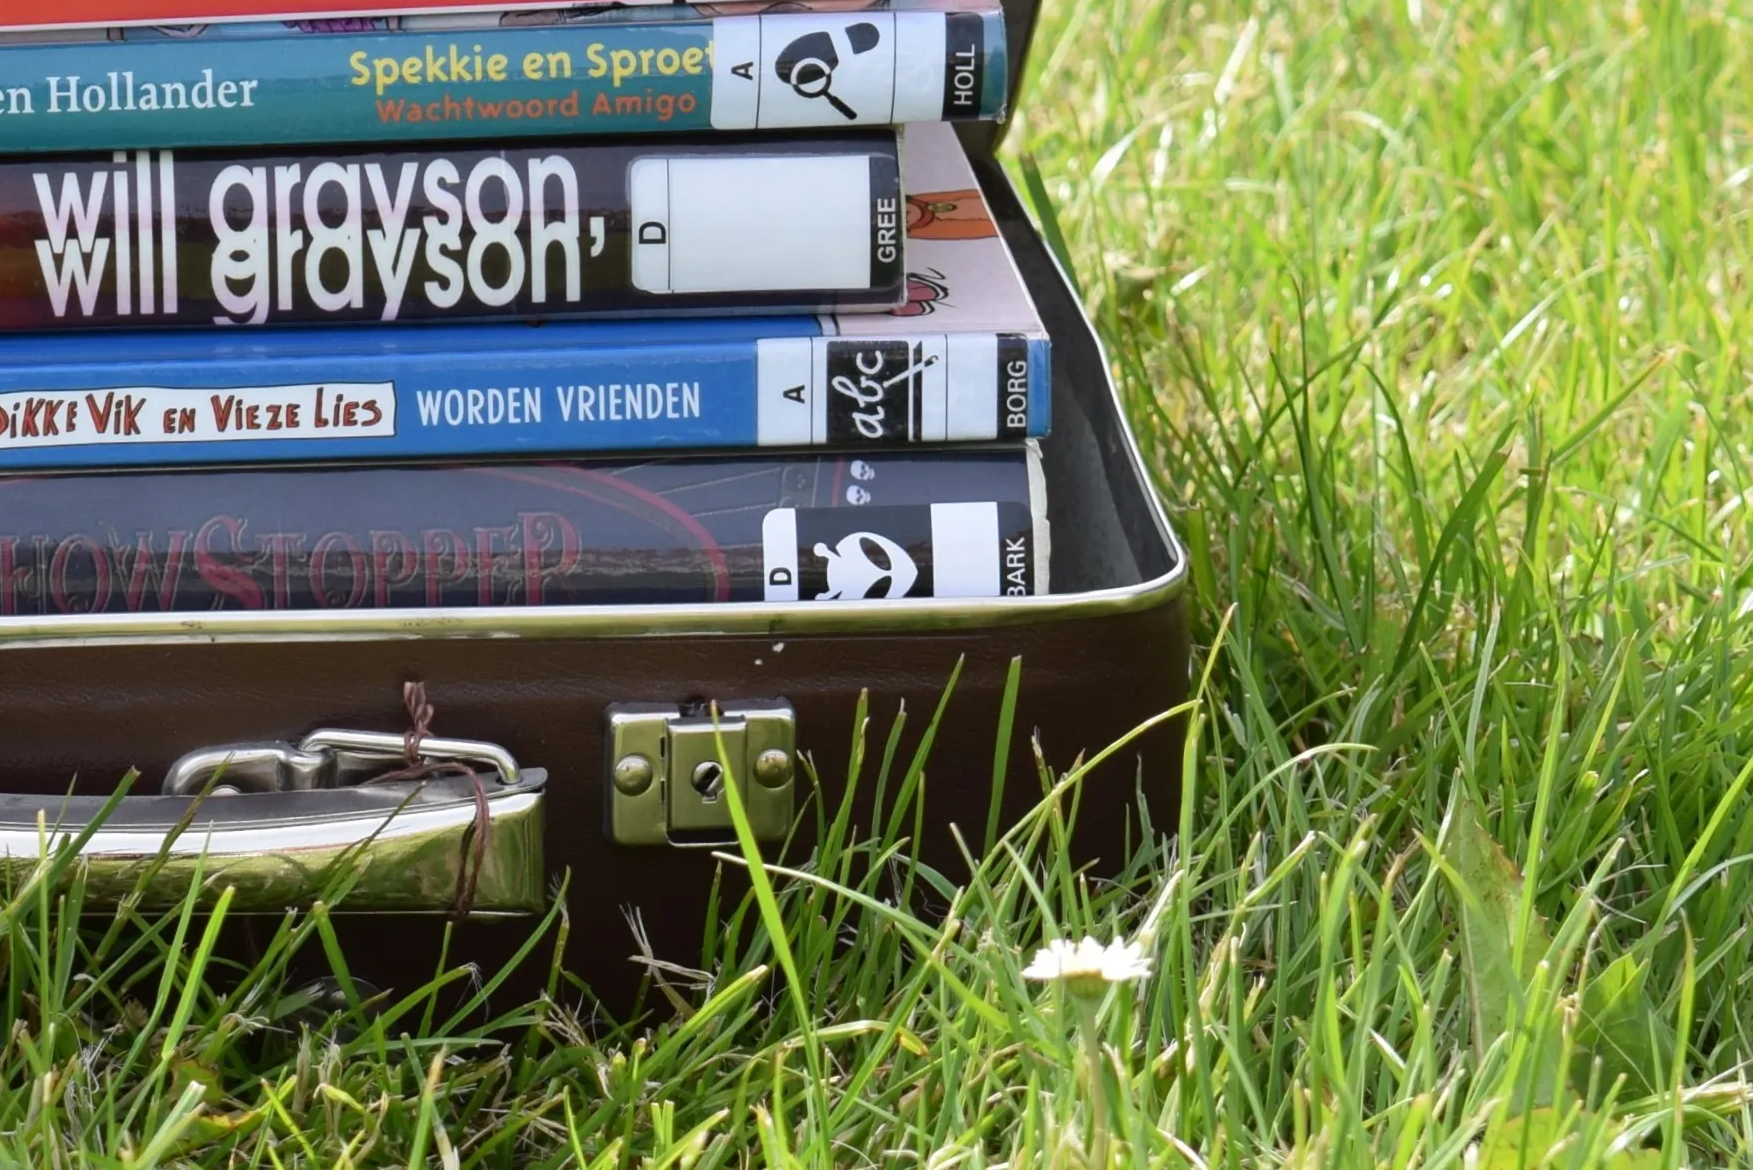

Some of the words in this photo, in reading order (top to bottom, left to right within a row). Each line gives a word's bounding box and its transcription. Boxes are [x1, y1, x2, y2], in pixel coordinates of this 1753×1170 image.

[47, 68, 258, 114] Hollander
[350, 45, 515, 97] Spekkie
[523, 51, 574, 80] en
[730, 60, 754, 81] A
[953, 43, 976, 107] HOLL
[376, 90, 580, 124] Wachtwoord
[592, 89, 696, 123] Amigo
[33, 150, 175, 253] will
[638, 221, 666, 245] D
[876, 197, 897, 263] GREE
[416, 386, 541, 428] WORDEN
[556, 381, 701, 422] VRIENDEN
[783, 385, 805, 404] A
[831, 350, 885, 438] abc
[1007, 360, 1027, 428] BORG
[769, 567, 792, 585] D
[1007, 537, 1027, 597] BARK
